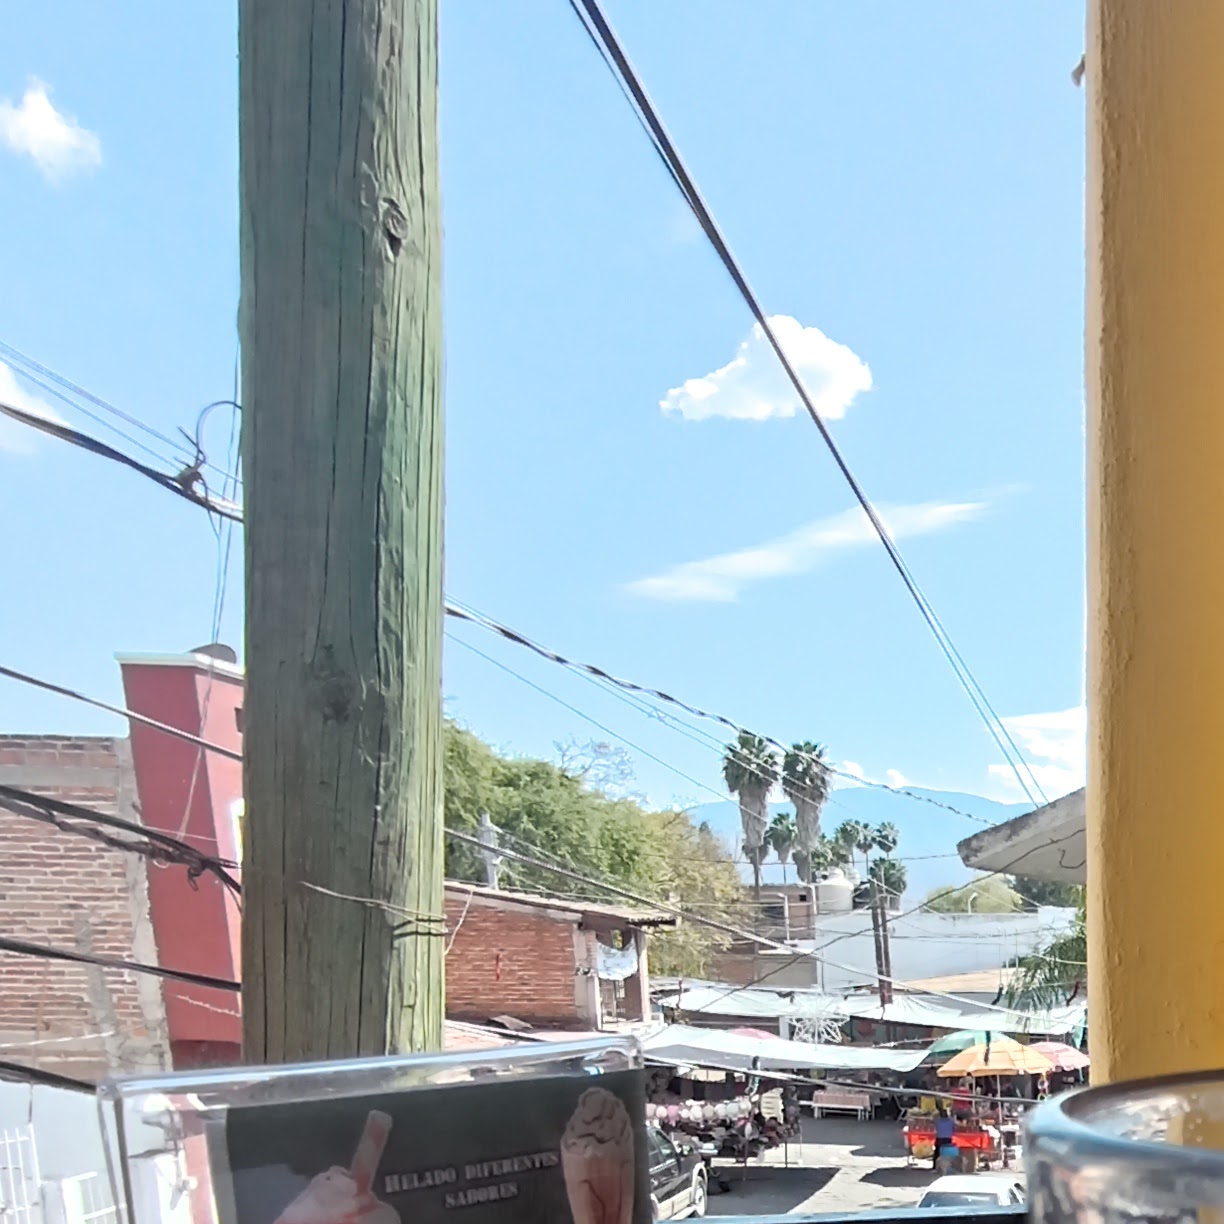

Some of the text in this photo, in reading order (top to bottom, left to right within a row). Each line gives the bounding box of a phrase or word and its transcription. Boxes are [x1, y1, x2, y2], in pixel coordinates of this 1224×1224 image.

[384, 1151, 560, 1194] HELADO DIFERENTES
[445, 1181, 518, 1209] SABORES
